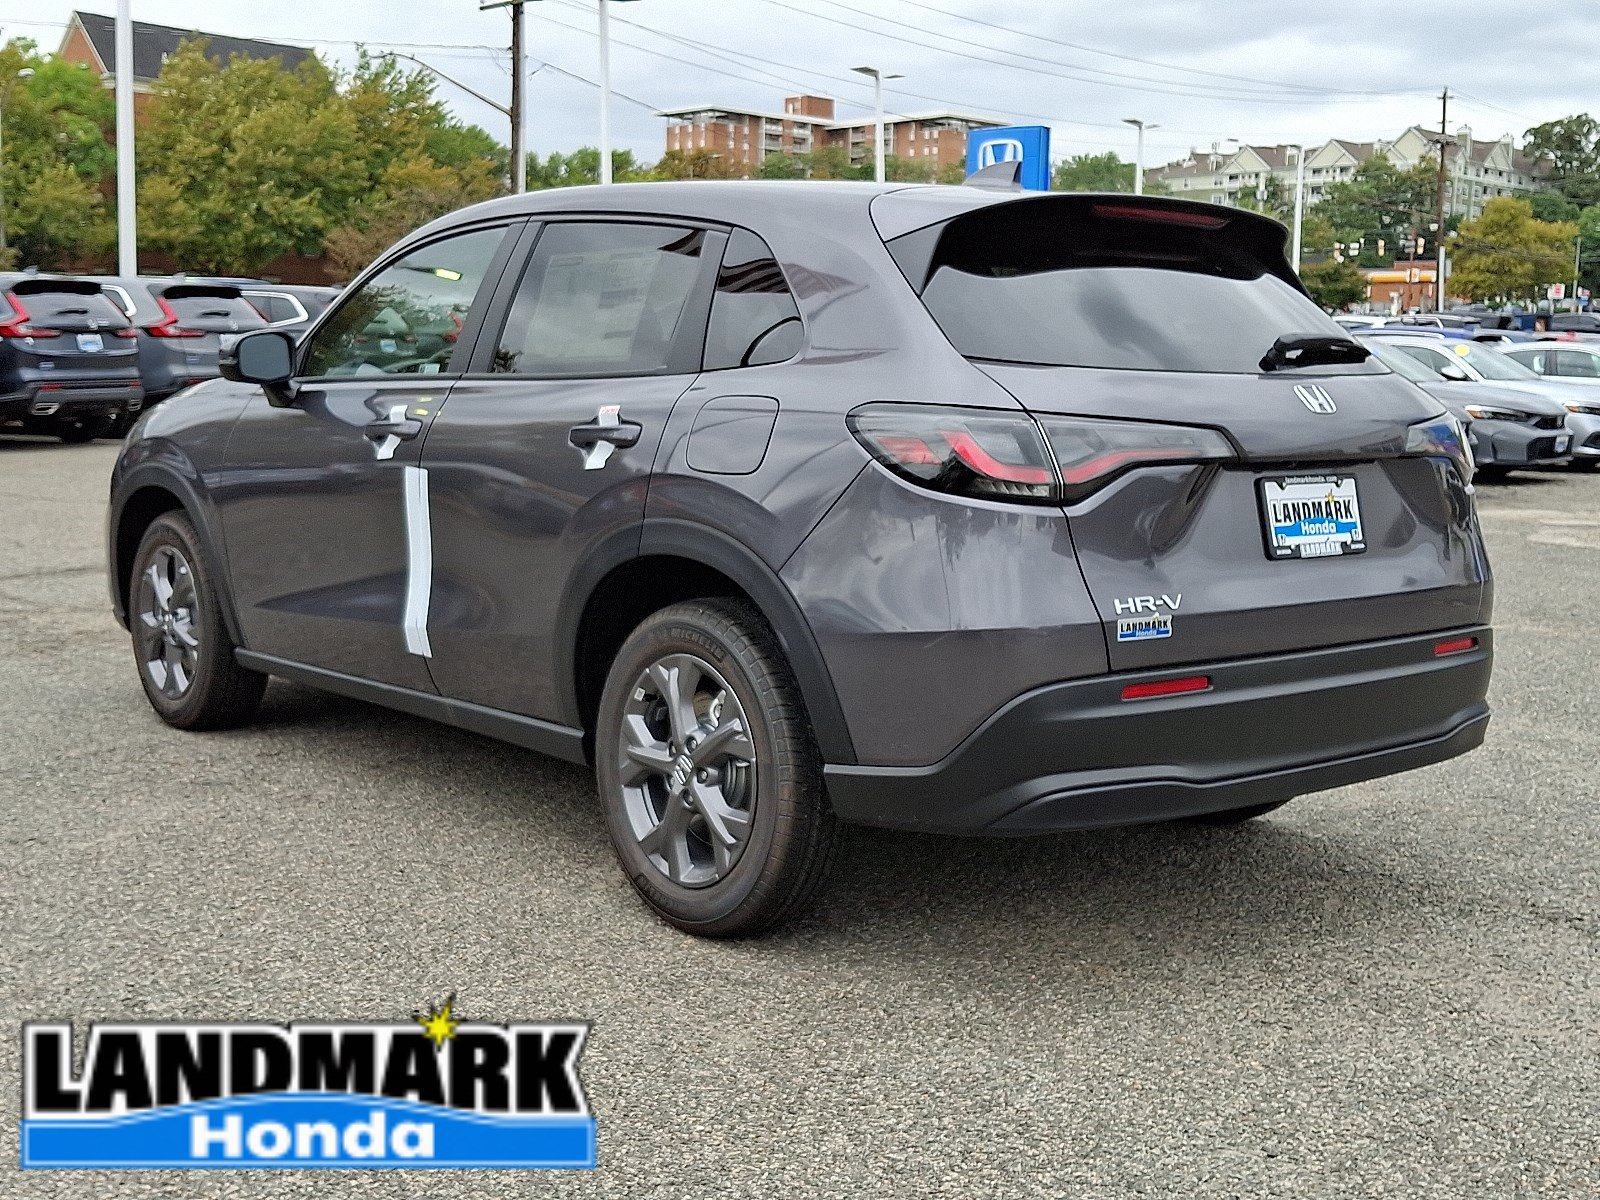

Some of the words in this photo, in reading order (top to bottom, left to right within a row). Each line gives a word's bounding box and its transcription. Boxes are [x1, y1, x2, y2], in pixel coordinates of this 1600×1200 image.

[1272, 498, 1353, 523] LANDMARK
[1300, 520, 1337, 535] Honda
[1301, 541, 1342, 554] LANDMARK
[1113, 593, 1182, 615] HR-V
[1120, 619, 1168, 633] LANDMARK
[1136, 629, 1157, 638] Honda
[670, 628, 724, 658] MICHELIN
